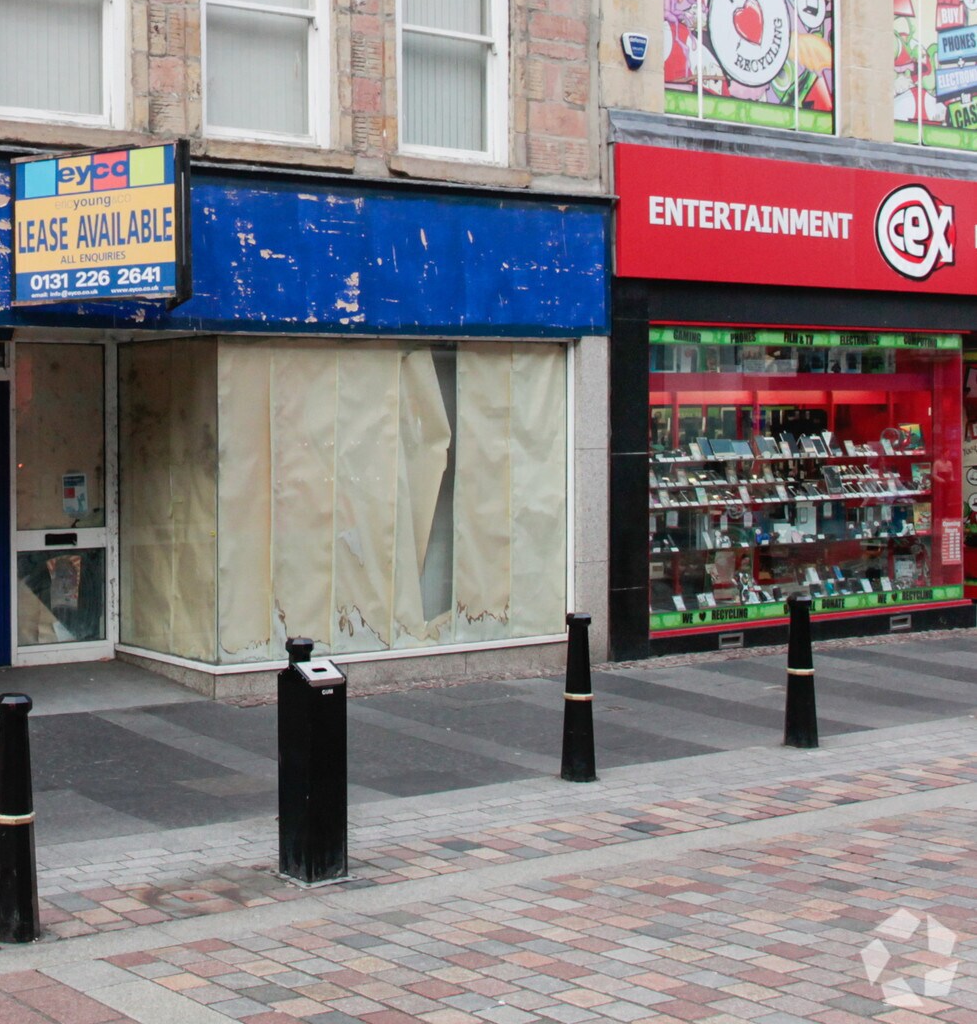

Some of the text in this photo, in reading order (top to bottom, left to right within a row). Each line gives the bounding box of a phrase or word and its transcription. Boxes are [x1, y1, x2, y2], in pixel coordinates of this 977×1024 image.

[734, 17, 783, 73] RECYCLING
[942, 32, 976, 53] PHONES
[57, 160, 128, 186] eyco
[649, 196, 853, 240] ENTERTAINMENT
[18, 207, 173, 254] LEASE AVAILABLE
[60, 251, 127, 265] ALL ENQUIRIES
[30, 266, 161, 290] 0131 226 2641
[110, 285, 159, 294] www.eyco.co.uk
[673, 329, 702, 344] GAMING
[822, 598, 845, 609] DONATE
[877, 589, 933, 604] WE RECYCLING
[682, 608, 748, 624] WE RECYCLING
